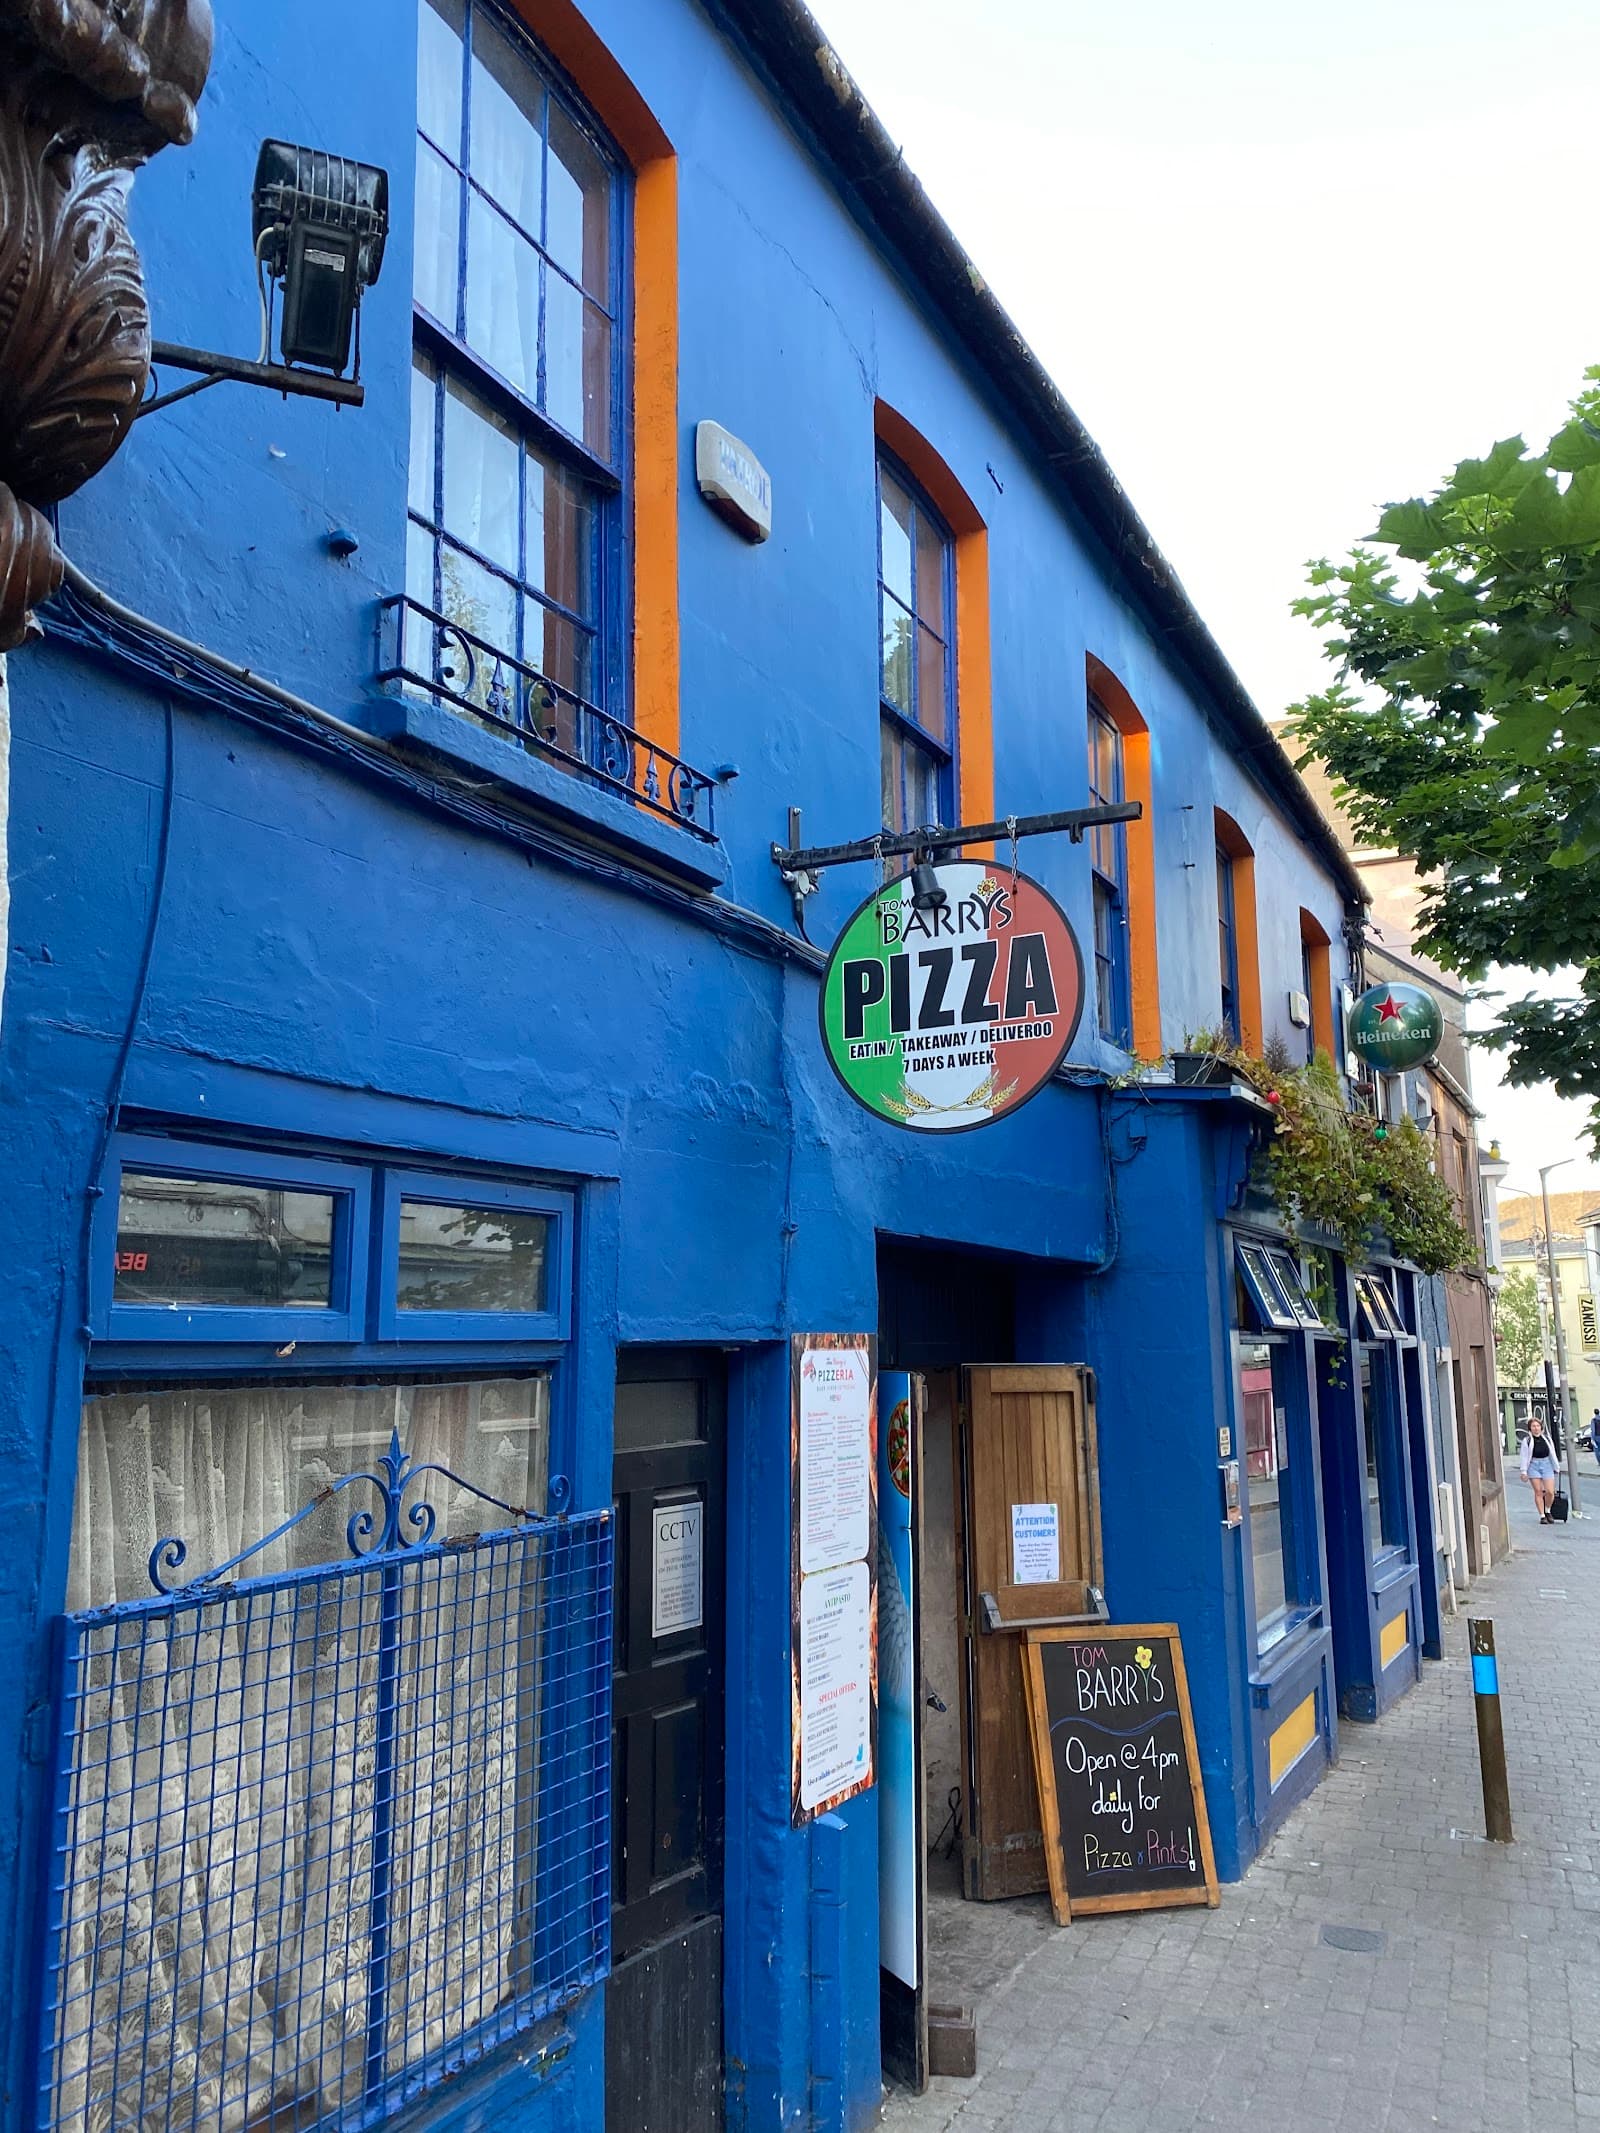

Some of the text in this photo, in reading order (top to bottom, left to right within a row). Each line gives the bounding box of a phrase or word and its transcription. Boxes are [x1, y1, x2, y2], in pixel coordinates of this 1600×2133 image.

[880, 899, 912, 913] TOM
[843, 933, 1058, 1040] PIZZA
[850, 1043, 872, 1059] EAT
[875, 1041, 887, 1056] IN
[901, 1032, 967, 1053] TAKEAWAY
[980, 1021, 1052, 1044] DELIVEROO
[1356, 1027, 1431, 1045] Heineken
[903, 1049, 995, 1073] 7 DAYS A WEEK
[1581, 1299, 1597, 1344] ZANUSSI
[818, 1368, 854, 1381] PIZZERIA
[660, 1519, 696, 1541] CCTV
[1016, 1516, 1054, 1526] ATTENTION
[1015, 1529, 1056, 1538] CUSTOMERS
[1067, 1645, 1109, 1668] TOM
[1076, 1664, 1164, 1712] BARRYS
[1066, 1736, 1117, 1787] Open
[1092, 1776, 1161, 1834] daily for
[1083, 1833, 1133, 1871] Pizza
[1146, 1825, 1197, 1872] Pints!
